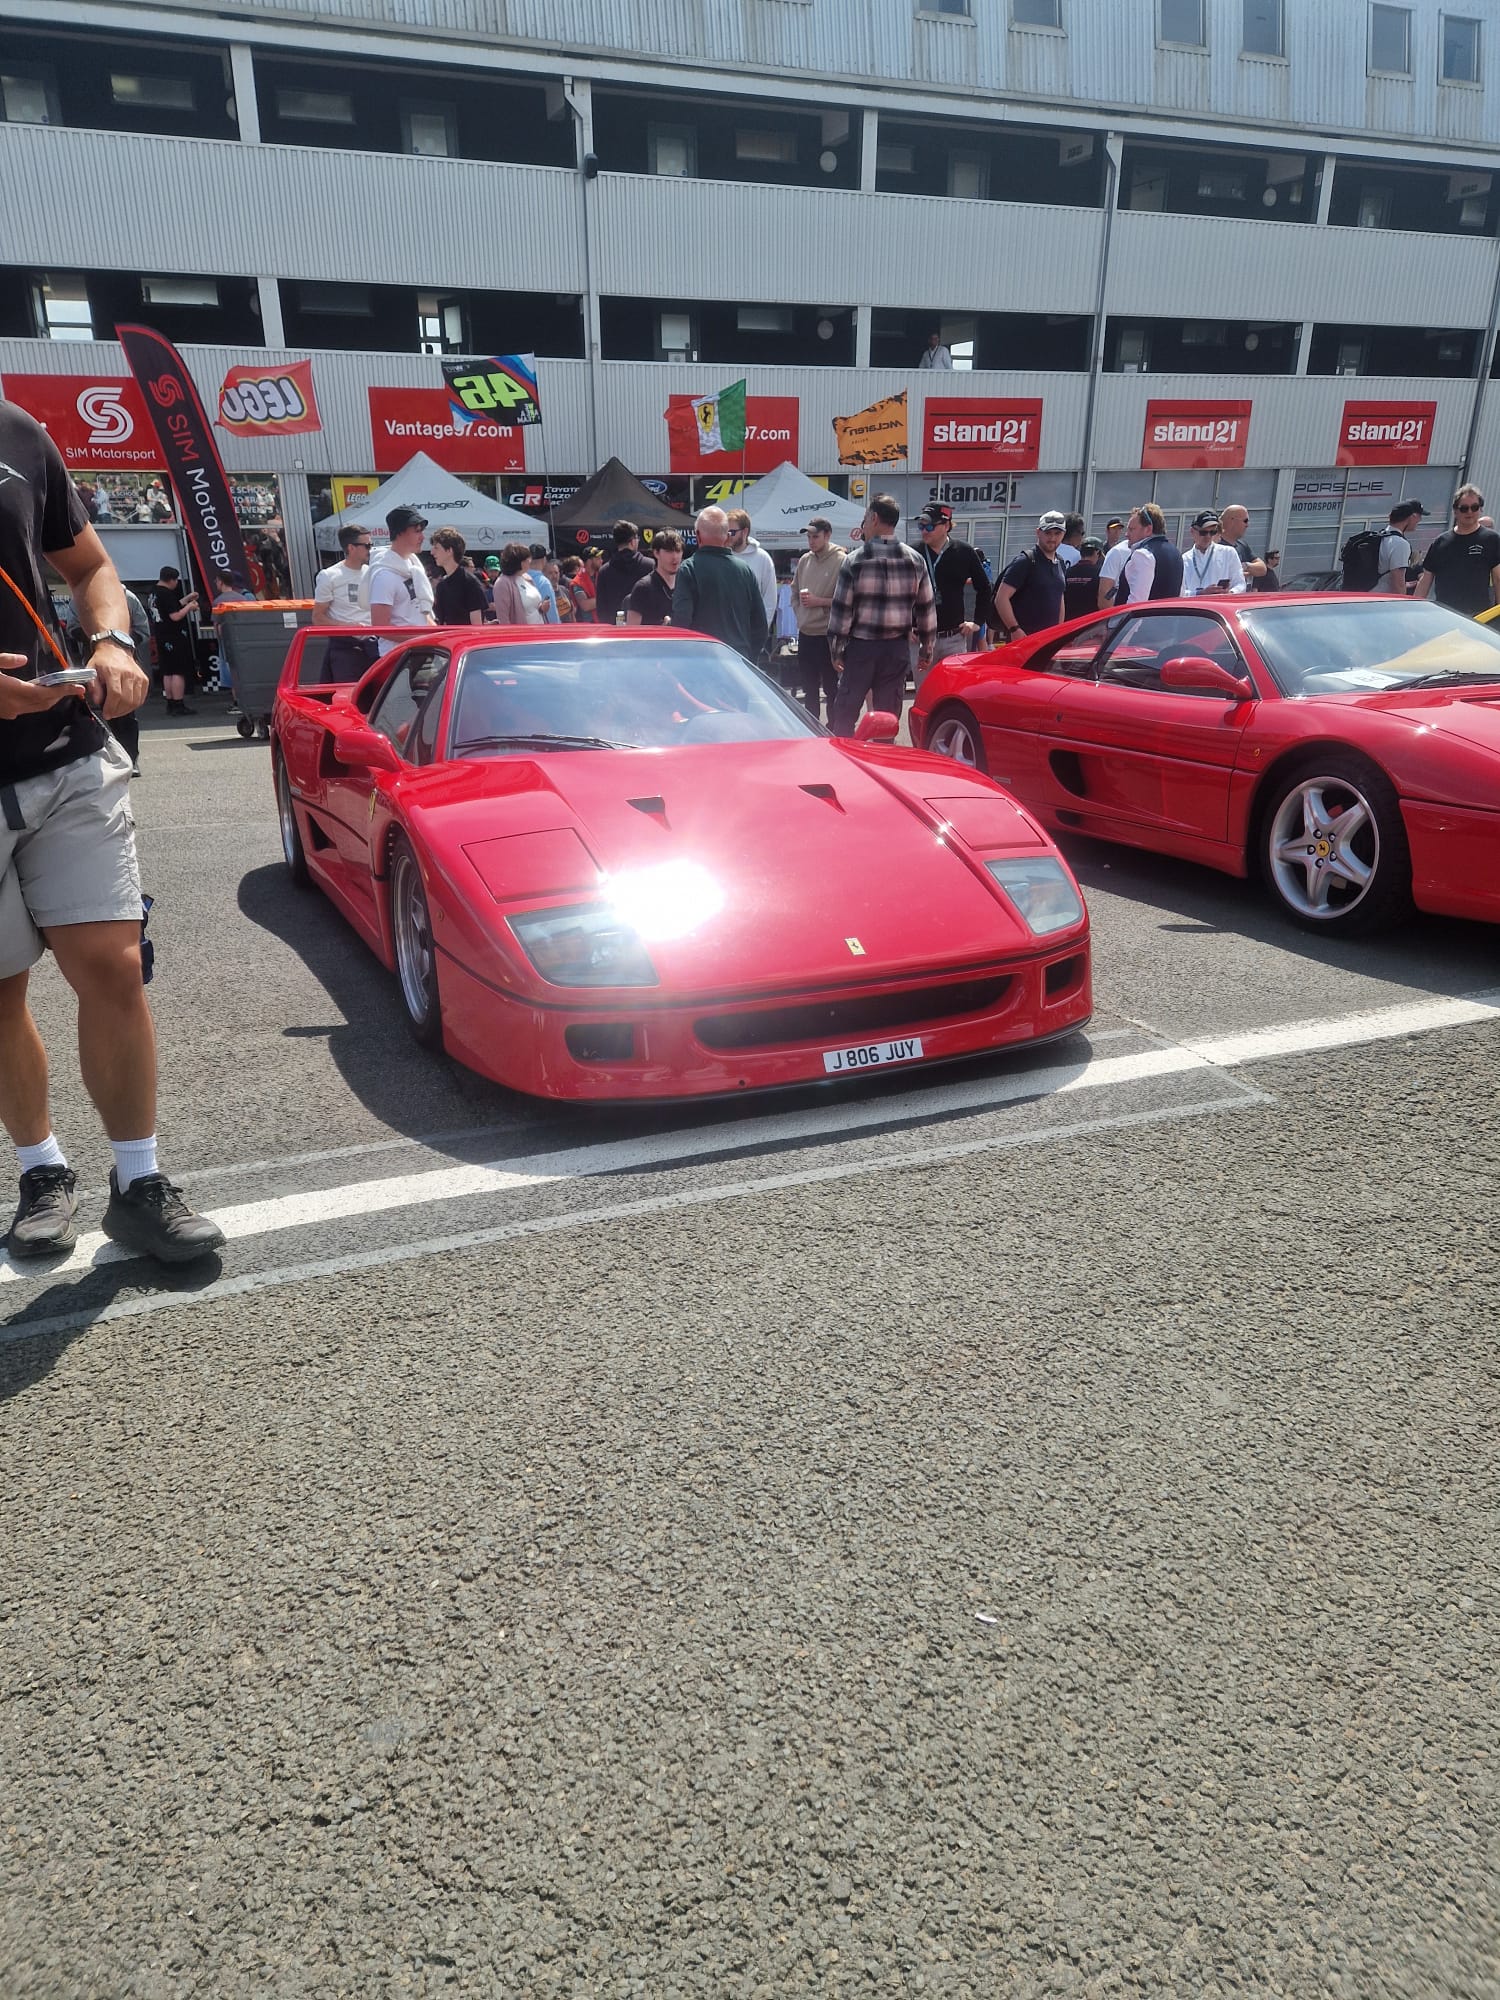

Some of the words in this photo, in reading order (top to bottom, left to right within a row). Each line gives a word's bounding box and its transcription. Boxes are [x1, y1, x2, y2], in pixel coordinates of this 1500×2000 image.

[933, 420, 1027, 444] stand21
[1153, 420, 1237, 443] stand21
[1347, 420, 1423, 442] stand21
[66, 447, 88, 459] SIM
[91, 447, 157, 461] Motorsport
[167, 414, 200, 462] SIM
[186, 468, 232, 573] Motorsp
[929, 482, 1017, 503] stand21
[1294, 481, 1384, 493] PORSCHE
[509, 493, 541, 505] GR
[781, 500, 837, 514] Vantage97
[1292, 502, 1345, 512] MOTORSPORT
[833, 1053, 843, 1070] J
[846, 1046, 880, 1067] 806
[885, 1040, 915, 1062] JUY
